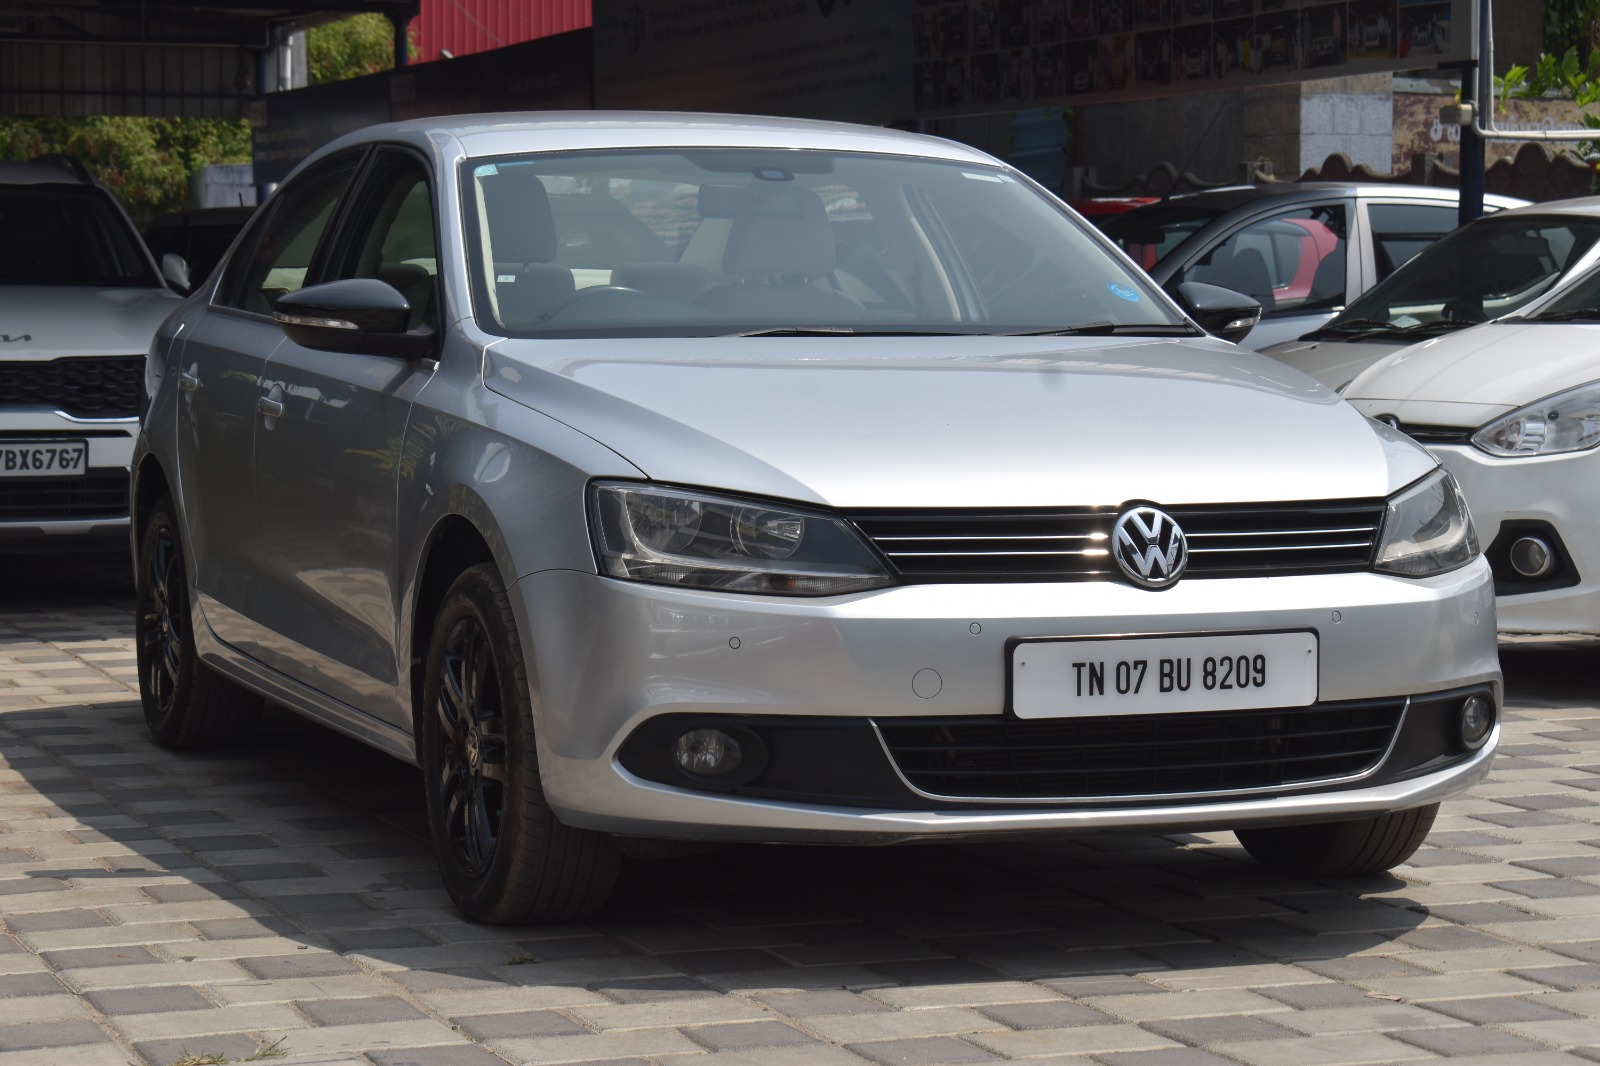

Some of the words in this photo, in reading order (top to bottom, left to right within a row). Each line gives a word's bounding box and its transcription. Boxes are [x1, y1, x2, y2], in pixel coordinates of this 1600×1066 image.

[1072, 662, 1104, 696] TN
[1116, 660, 1147, 694] 07
[1159, 658, 1191, 692] BU
[1203, 654, 1266, 690] 8209
